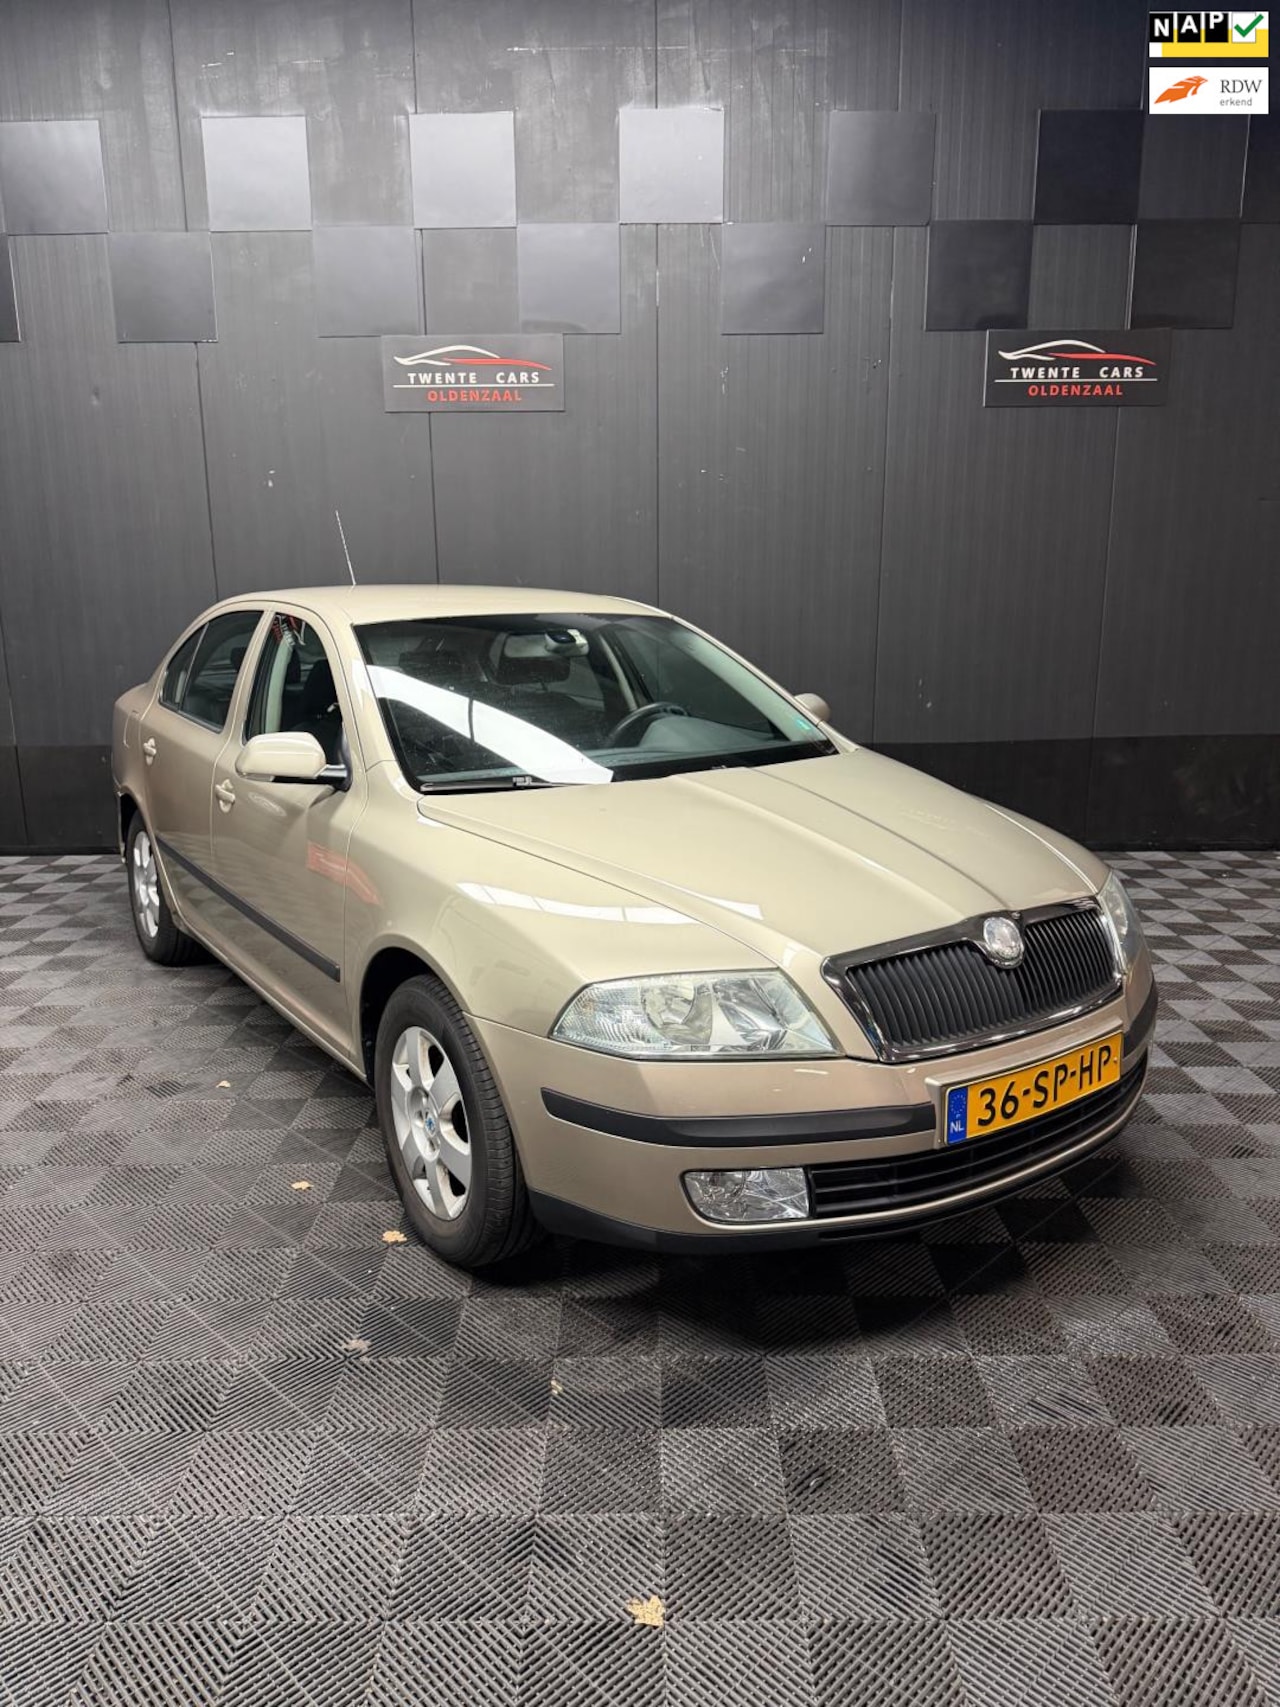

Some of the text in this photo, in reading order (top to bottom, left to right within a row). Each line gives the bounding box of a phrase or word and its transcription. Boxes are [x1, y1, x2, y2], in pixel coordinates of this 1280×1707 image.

[408, 371, 540, 384] TWENTE CARS
[1010, 366, 1144, 379] TWENTE CARS
[428, 388, 522, 402] OLDENZAAL
[1028, 384, 1123, 397] OLDENZAAL
[977, 1045, 1111, 1126] 36-SP-HP
[950, 1120, 964, 1133] NL
